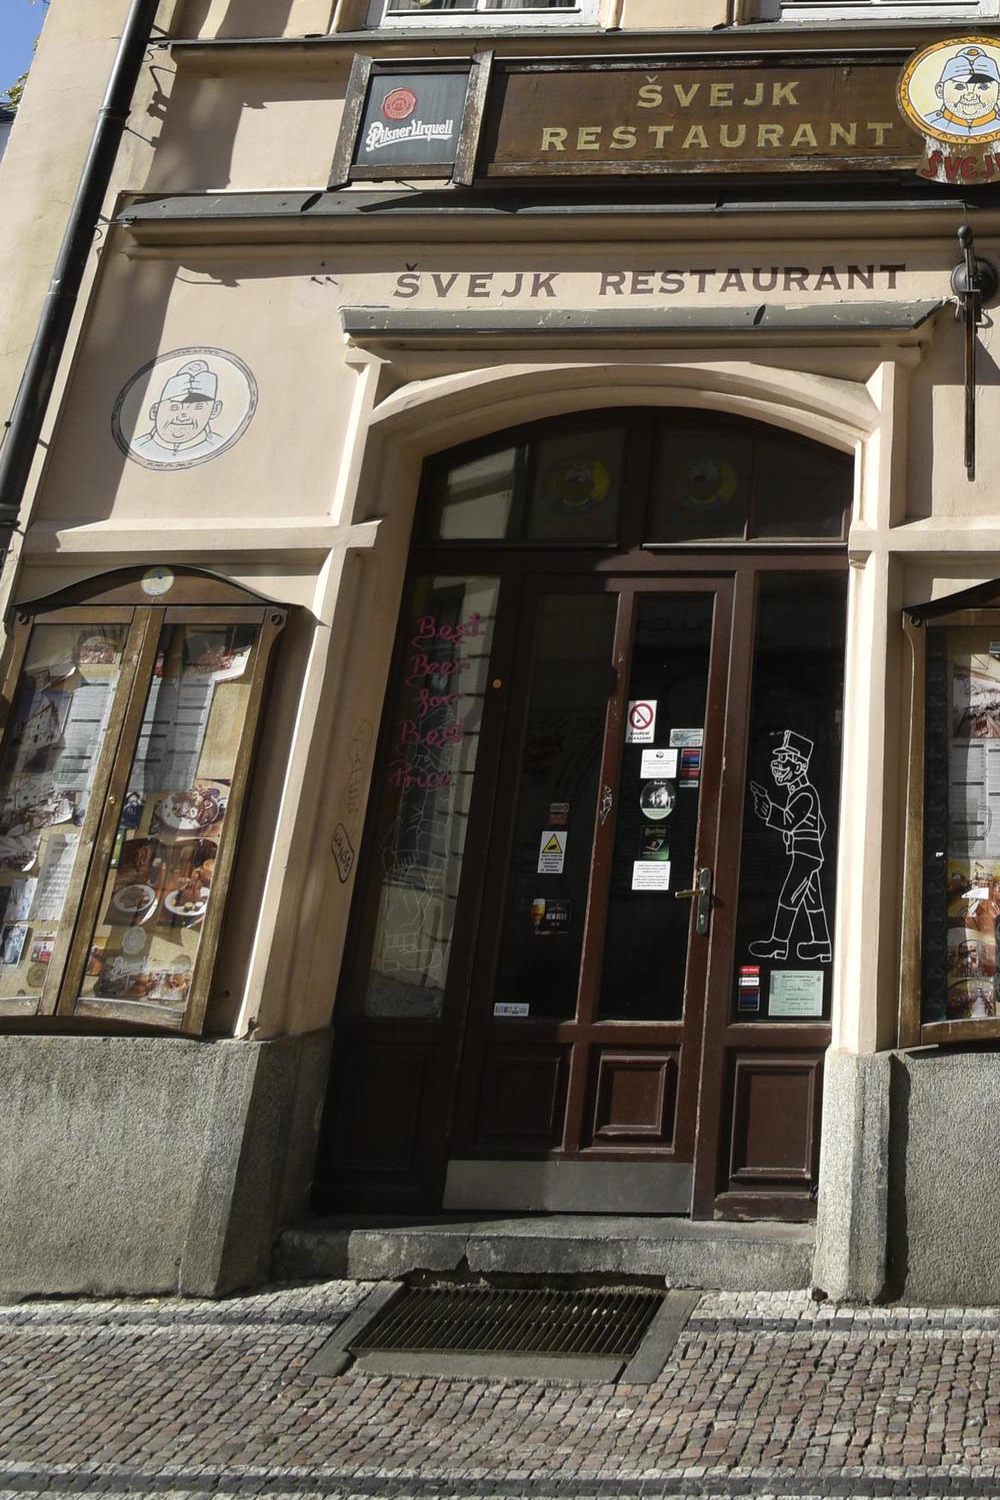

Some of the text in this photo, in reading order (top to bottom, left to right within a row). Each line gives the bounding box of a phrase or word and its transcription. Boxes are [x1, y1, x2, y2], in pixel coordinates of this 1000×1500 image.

[636, 75, 801, 108] ŠVEJK
[365, 119, 453, 152] Pilsner Urquell
[539, 121, 895, 151] RESTAURANT
[393, 263, 907, 298] ŠVEJK RESTAURANT
[412, 612, 487, 649] Best
[406, 653, 470, 686] Beer
